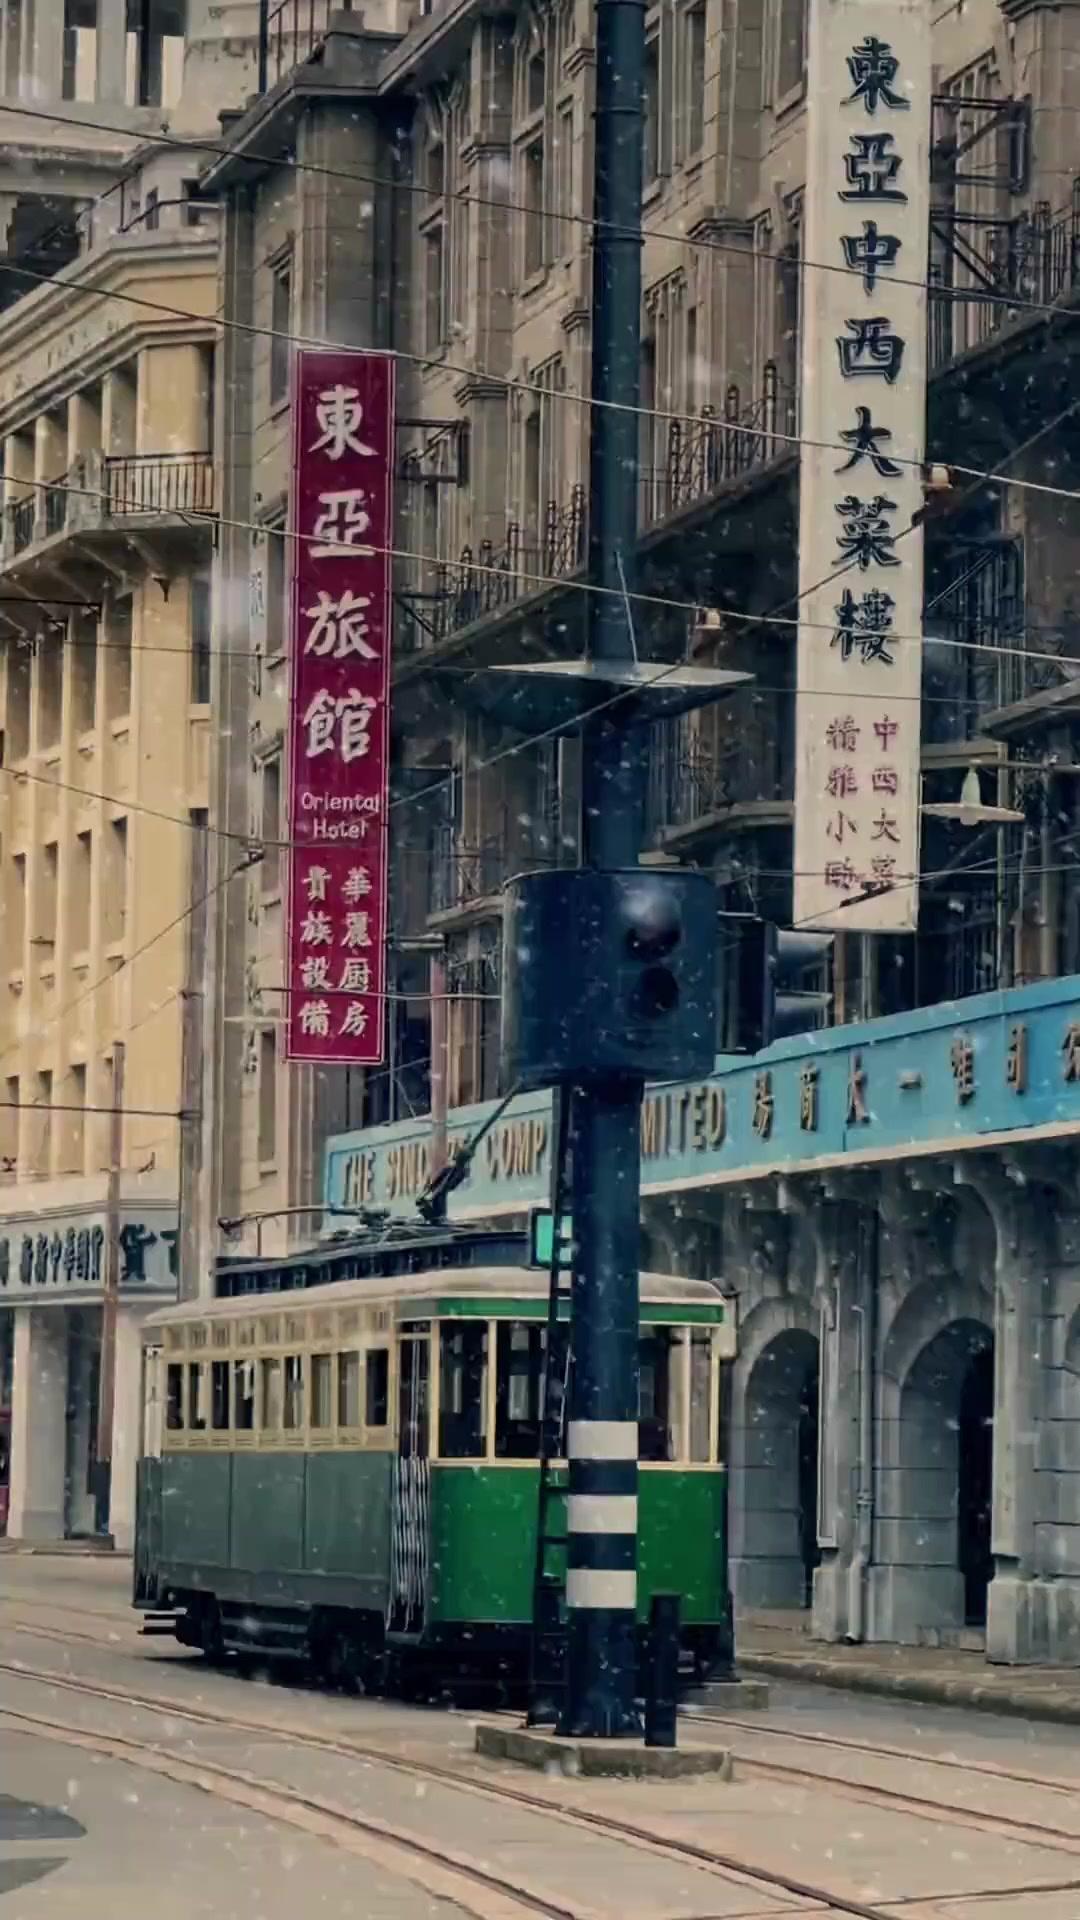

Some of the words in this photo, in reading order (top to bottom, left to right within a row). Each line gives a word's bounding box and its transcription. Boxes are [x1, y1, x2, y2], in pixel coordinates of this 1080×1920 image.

[830, 36, 910, 665] 東亞中西大菜樓
[304, 383, 381, 763] 東亞旅館
[302, 791, 379, 813] Oriental
[313, 818, 368, 840] Hotel
[342, 1151, 377, 1204] THE
[482, 1119, 548, 1181] COMP
[641, 1085, 727, 1158] MITED
